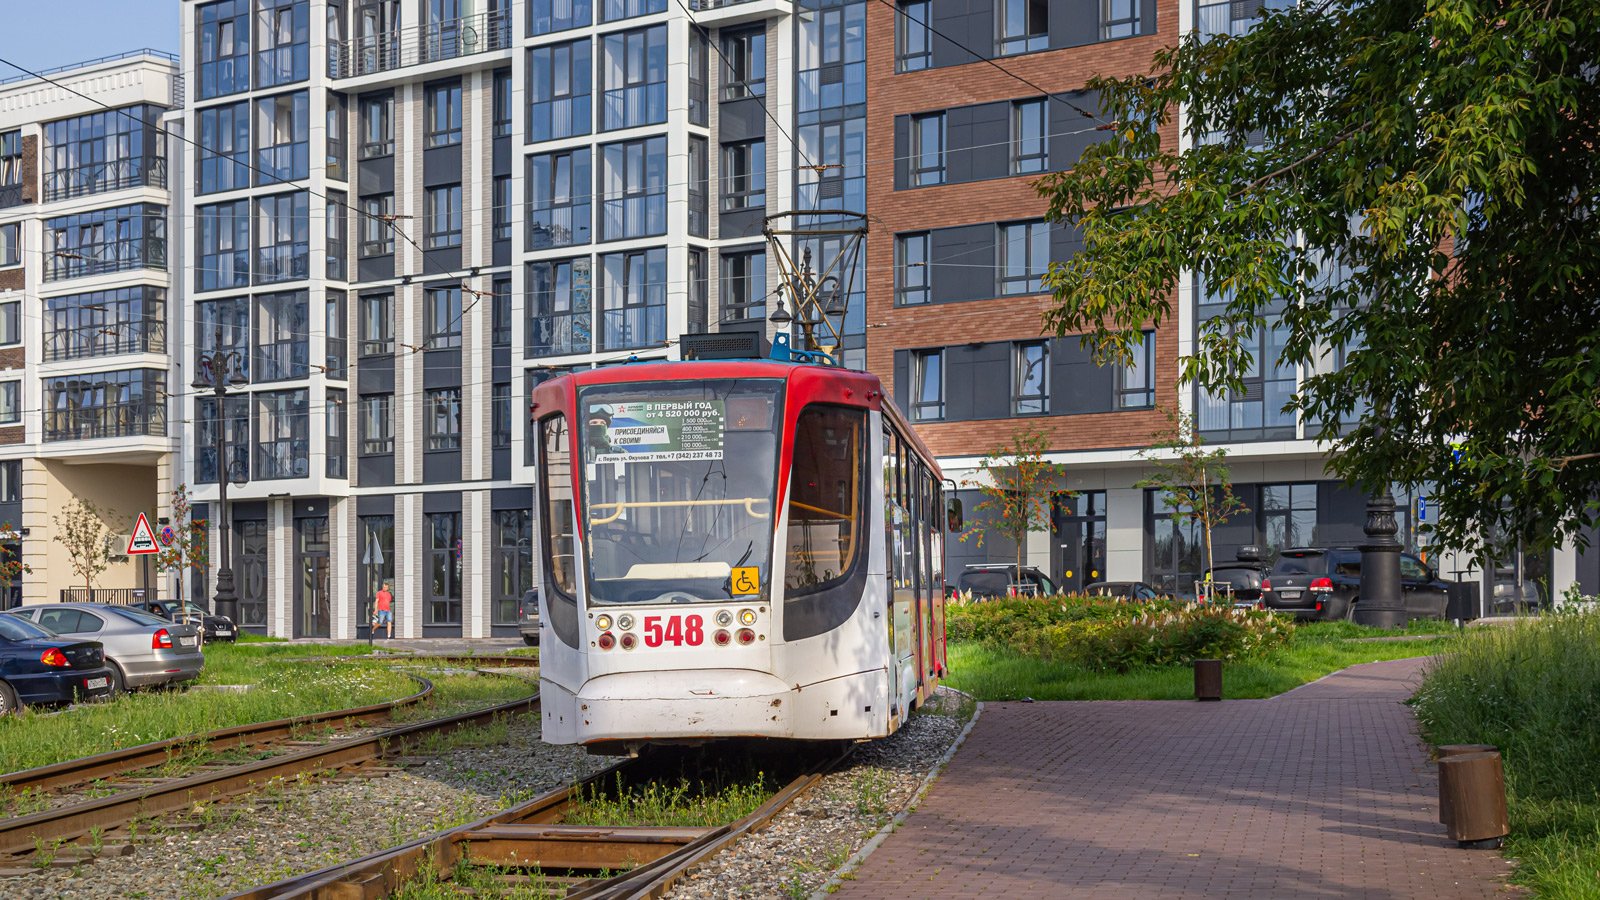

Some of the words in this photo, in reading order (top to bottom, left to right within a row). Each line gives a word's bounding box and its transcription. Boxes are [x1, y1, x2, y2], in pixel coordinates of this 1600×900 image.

[654, 401, 693, 411] ПЕРВЫЙ
[694, 402, 712, 410] ГОД
[702, 409, 720, 417] руб.
[614, 426, 665, 436] ПРИСОЕДИНЯЙСЯ
[675, 452, 692, 460] (342)
[644, 614, 704, 648] 548
